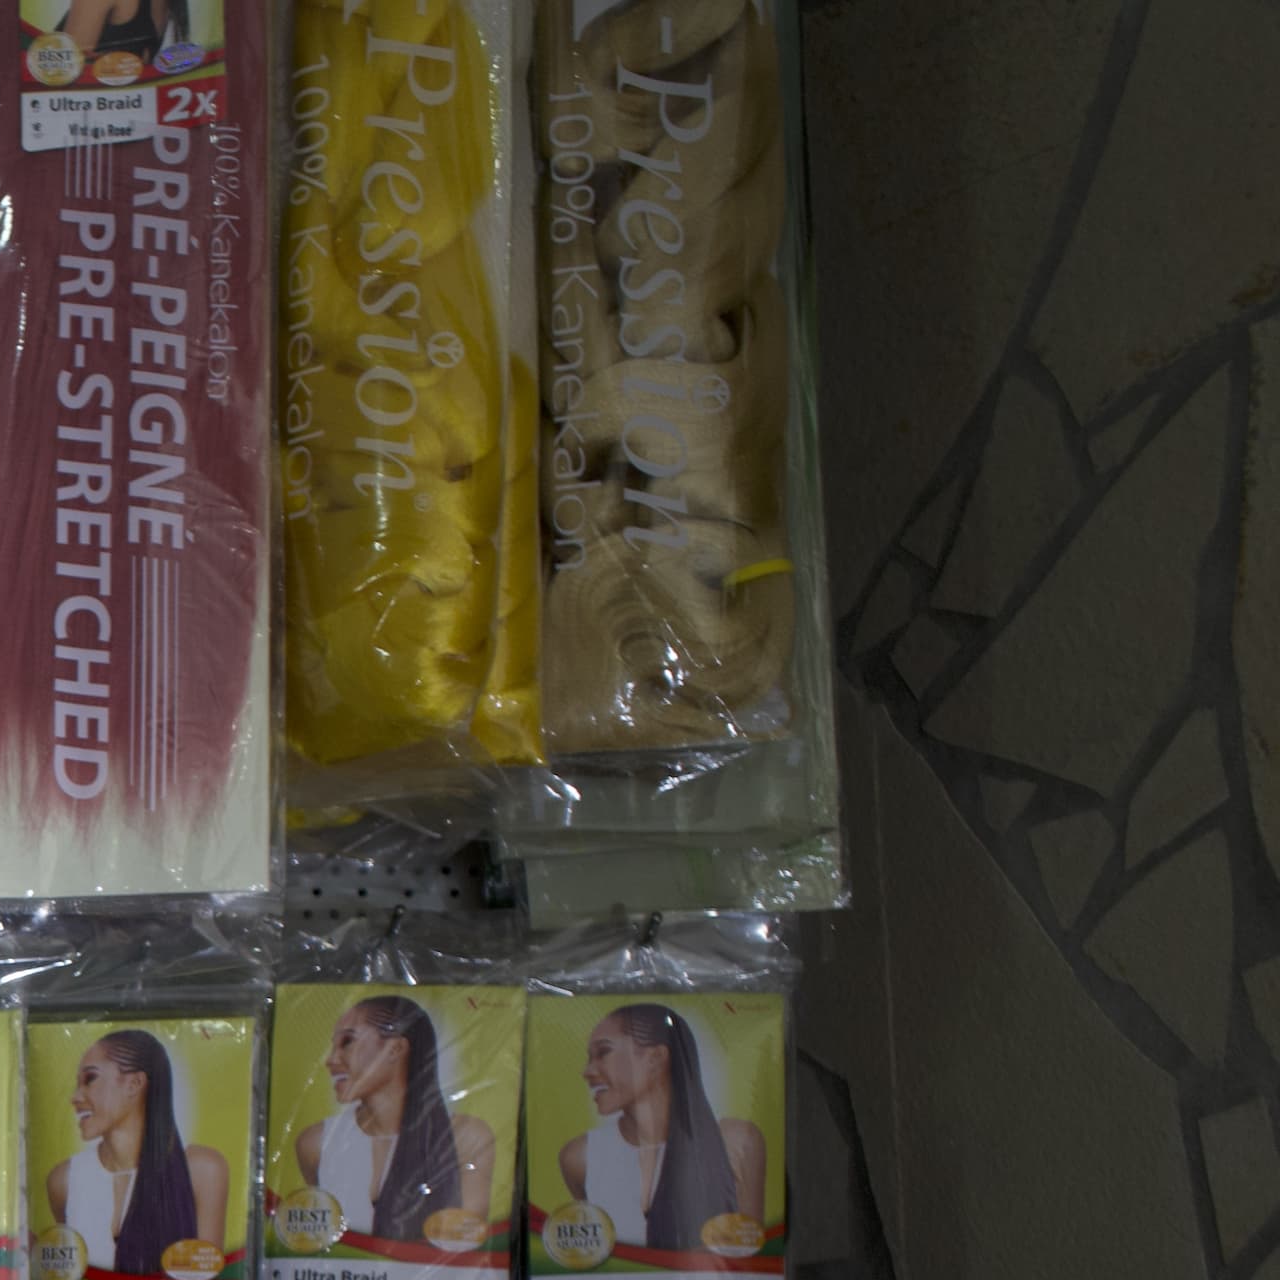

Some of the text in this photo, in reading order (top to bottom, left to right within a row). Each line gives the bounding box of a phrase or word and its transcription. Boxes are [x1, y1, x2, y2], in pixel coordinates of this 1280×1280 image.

[39, 52, 72, 62] BEST
[49, 95, 142, 112] Ultra Braid
[162, 87, 217, 121] 2x
[206, 210, 241, 399] Kanekalon
[288, 54, 330, 520] 100% Kanekalon
[343, 0, 465, 498] Pression
[127, 126, 196, 553] PRÉ-PEIGNÉ
[547, 83, 605, 571] 100% Kanekalon
[52, 208, 116, 801] PRE-STRETCHED
[42, 1248, 77, 1260] BEST
[288, 1209, 330, 1223] BEST
[557, 1224, 601, 1237] BEST
